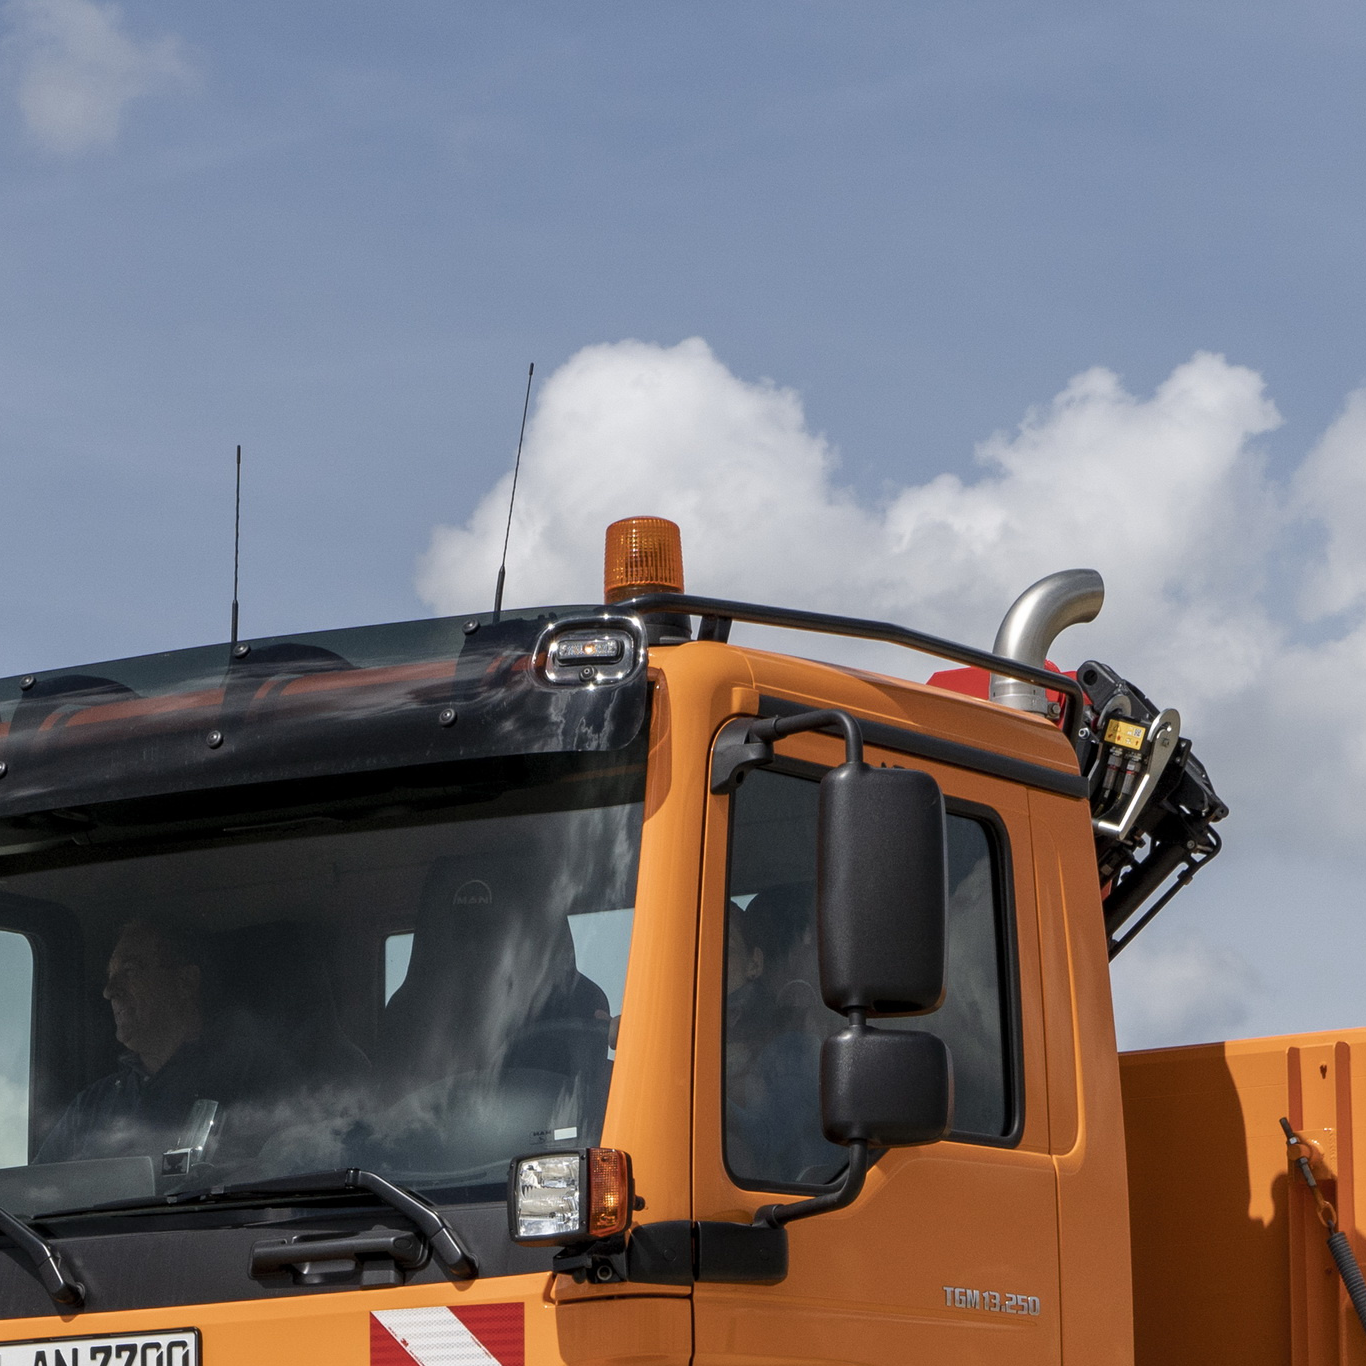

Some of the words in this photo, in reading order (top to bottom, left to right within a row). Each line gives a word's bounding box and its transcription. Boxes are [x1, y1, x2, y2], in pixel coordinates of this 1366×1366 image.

[456, 895, 489, 905] MAN
[942, 1286, 980, 1310] TGM
[982, 1290, 1041, 1316] 13.250
